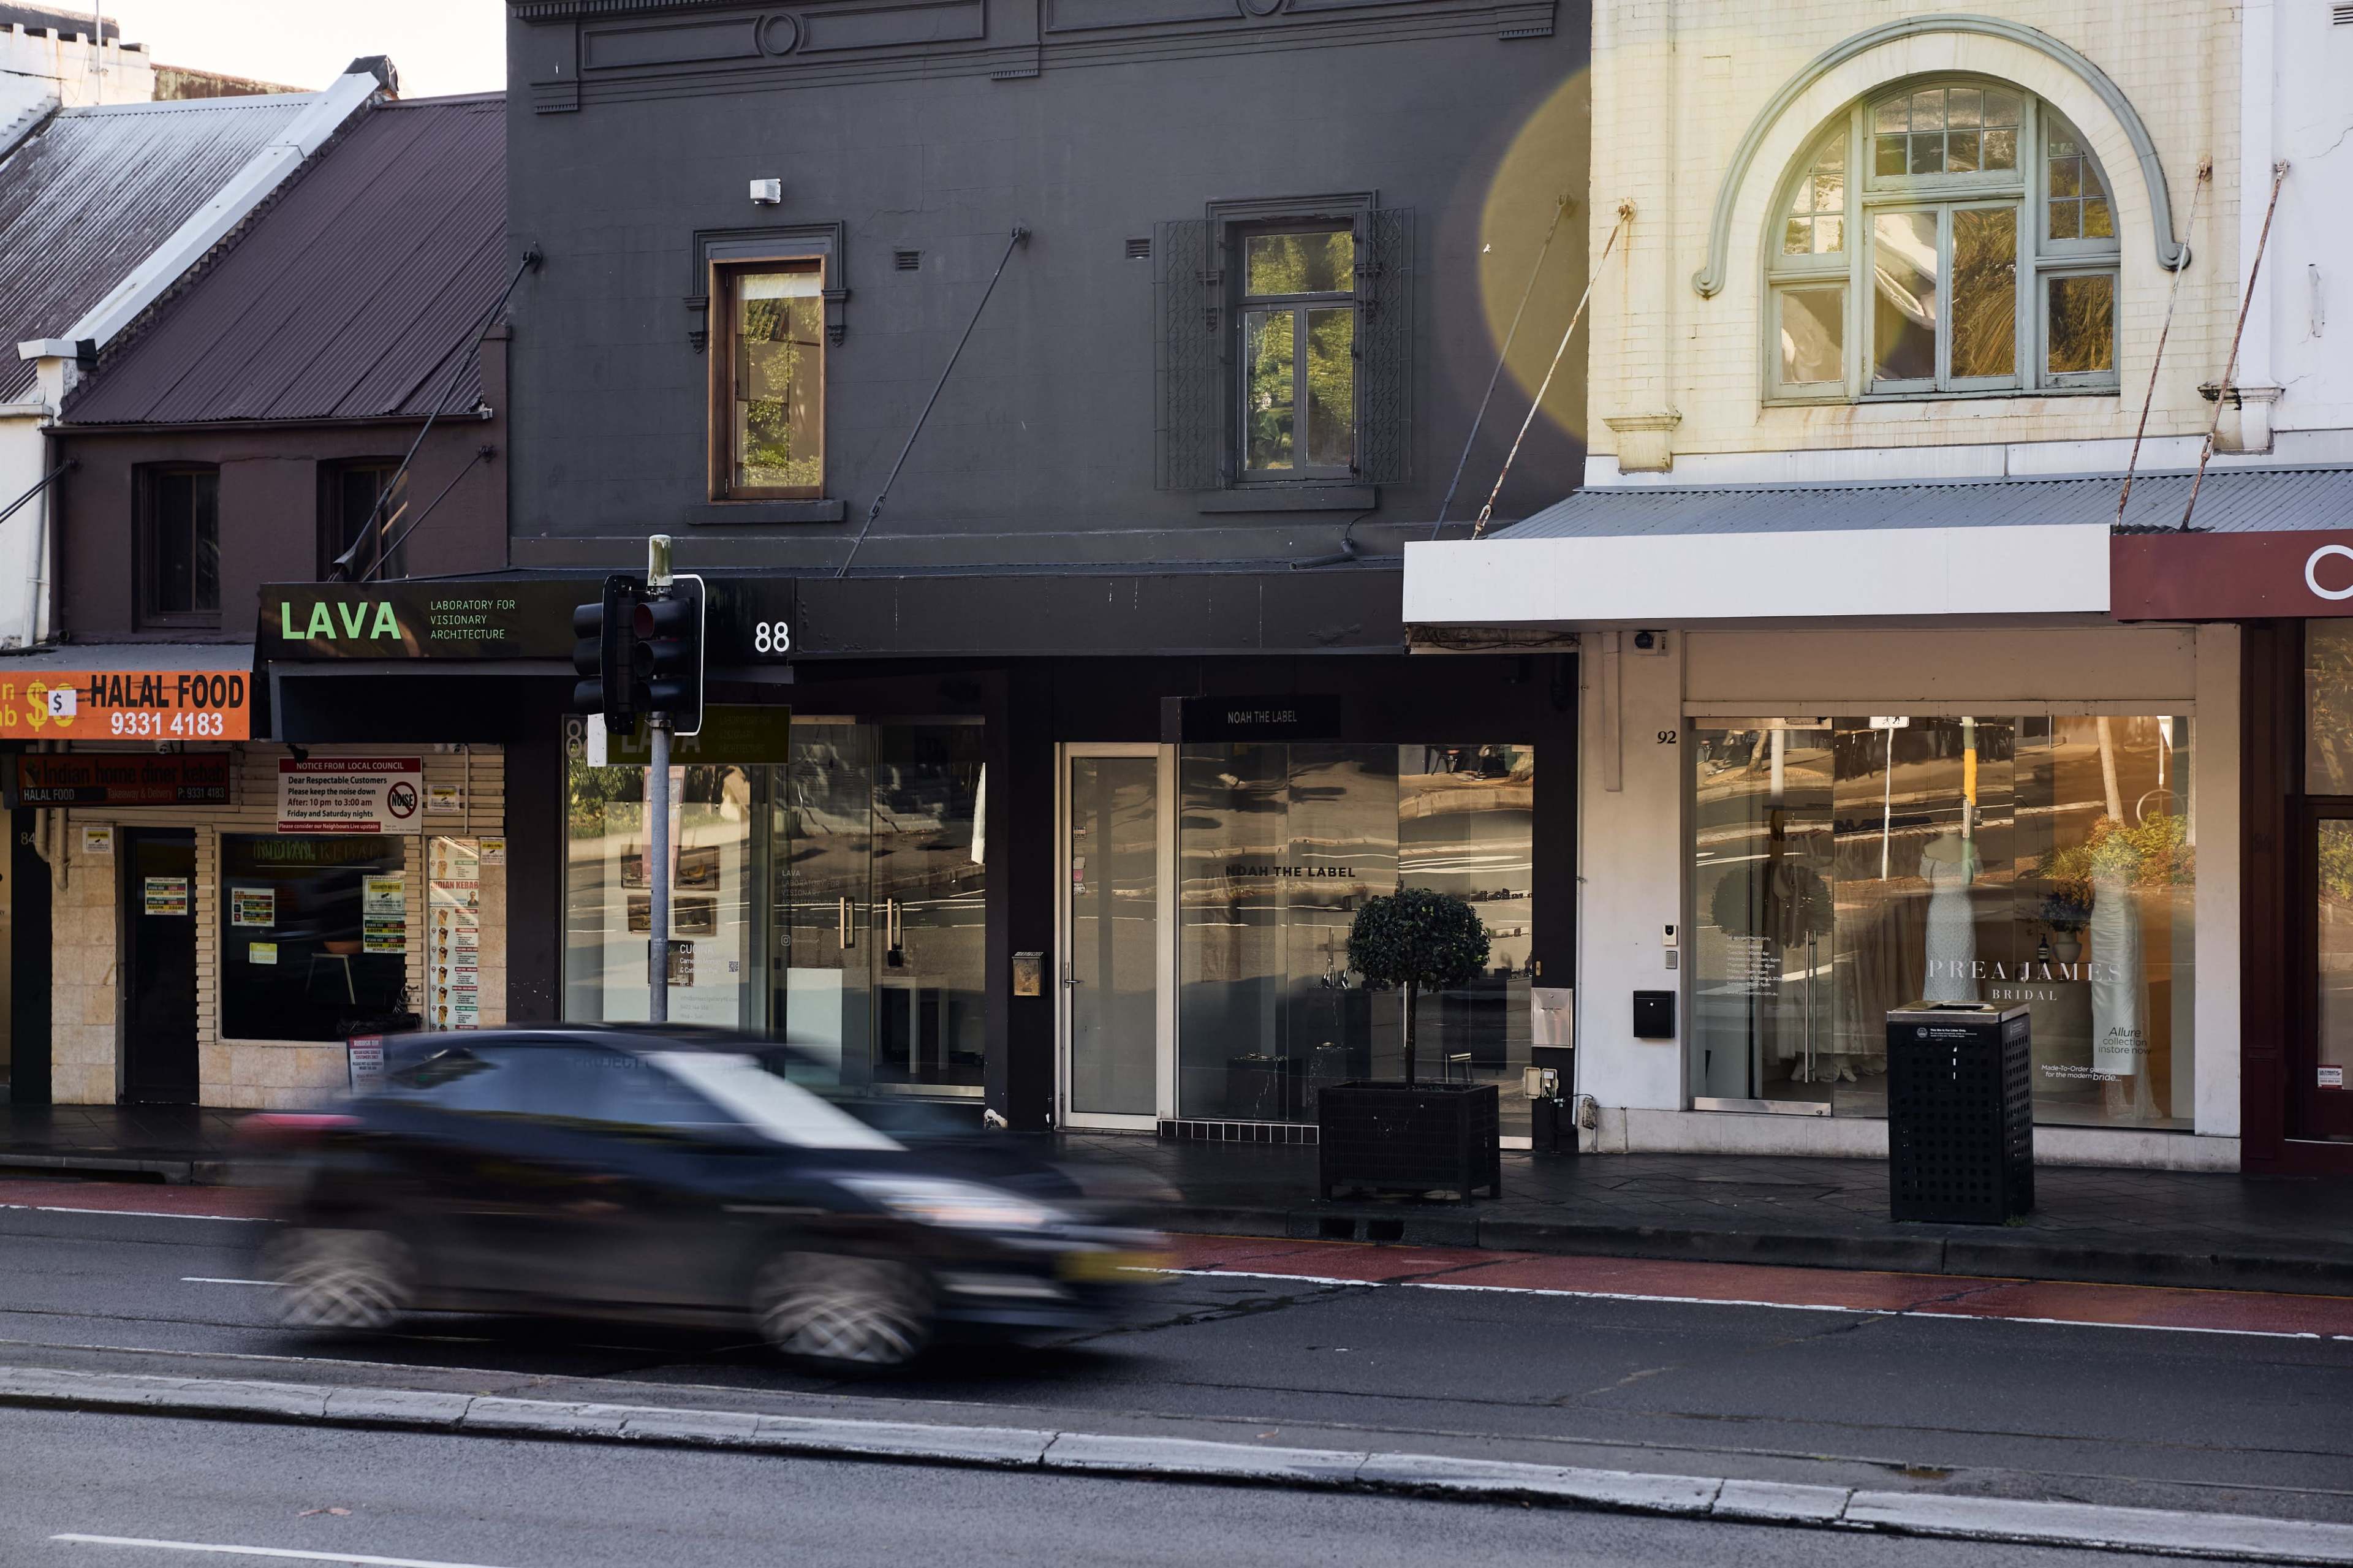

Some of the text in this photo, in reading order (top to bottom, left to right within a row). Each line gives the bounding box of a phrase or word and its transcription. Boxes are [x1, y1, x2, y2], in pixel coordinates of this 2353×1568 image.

[430, 599, 515, 610] LABORATORY FOR
[281, 602, 401, 640] LAVA
[430, 615, 487, 625] VISIONARY
[430, 629, 505, 640] ARCHITECTURE
[754, 621, 790, 653] 88
[91, 675, 244, 708] HALAL FOOD
[53, 693, 62, 713] $
[0, 704, 17, 726] b
[1228, 710, 1297, 723] NOAH THE LABEL
[111, 712, 223, 735] 9331 4183
[1656, 730, 1677, 744] 92
[44, 759, 225, 784] Indian home diner kebab
[24, 789, 75, 801] HALAL FOOD
[108, 788, 139, 800] Takeaway
[178, 787, 225, 798] P: 9331 4183
[392, 794, 413, 806] NOISE
[21, 831, 35, 845] 84
[1226, 866, 1356, 877] NOAH THE LABEL
[456, 881, 479, 890] KEBAB
[1930, 961, 2122, 981] PREA JAMES
[1992, 989, 2058, 1001] BRIDAL
[2109, 1027, 2142, 1037] Allure
[2102, 1037, 2148, 1047] collection
[2093, 1074, 2122, 1082] bride...
